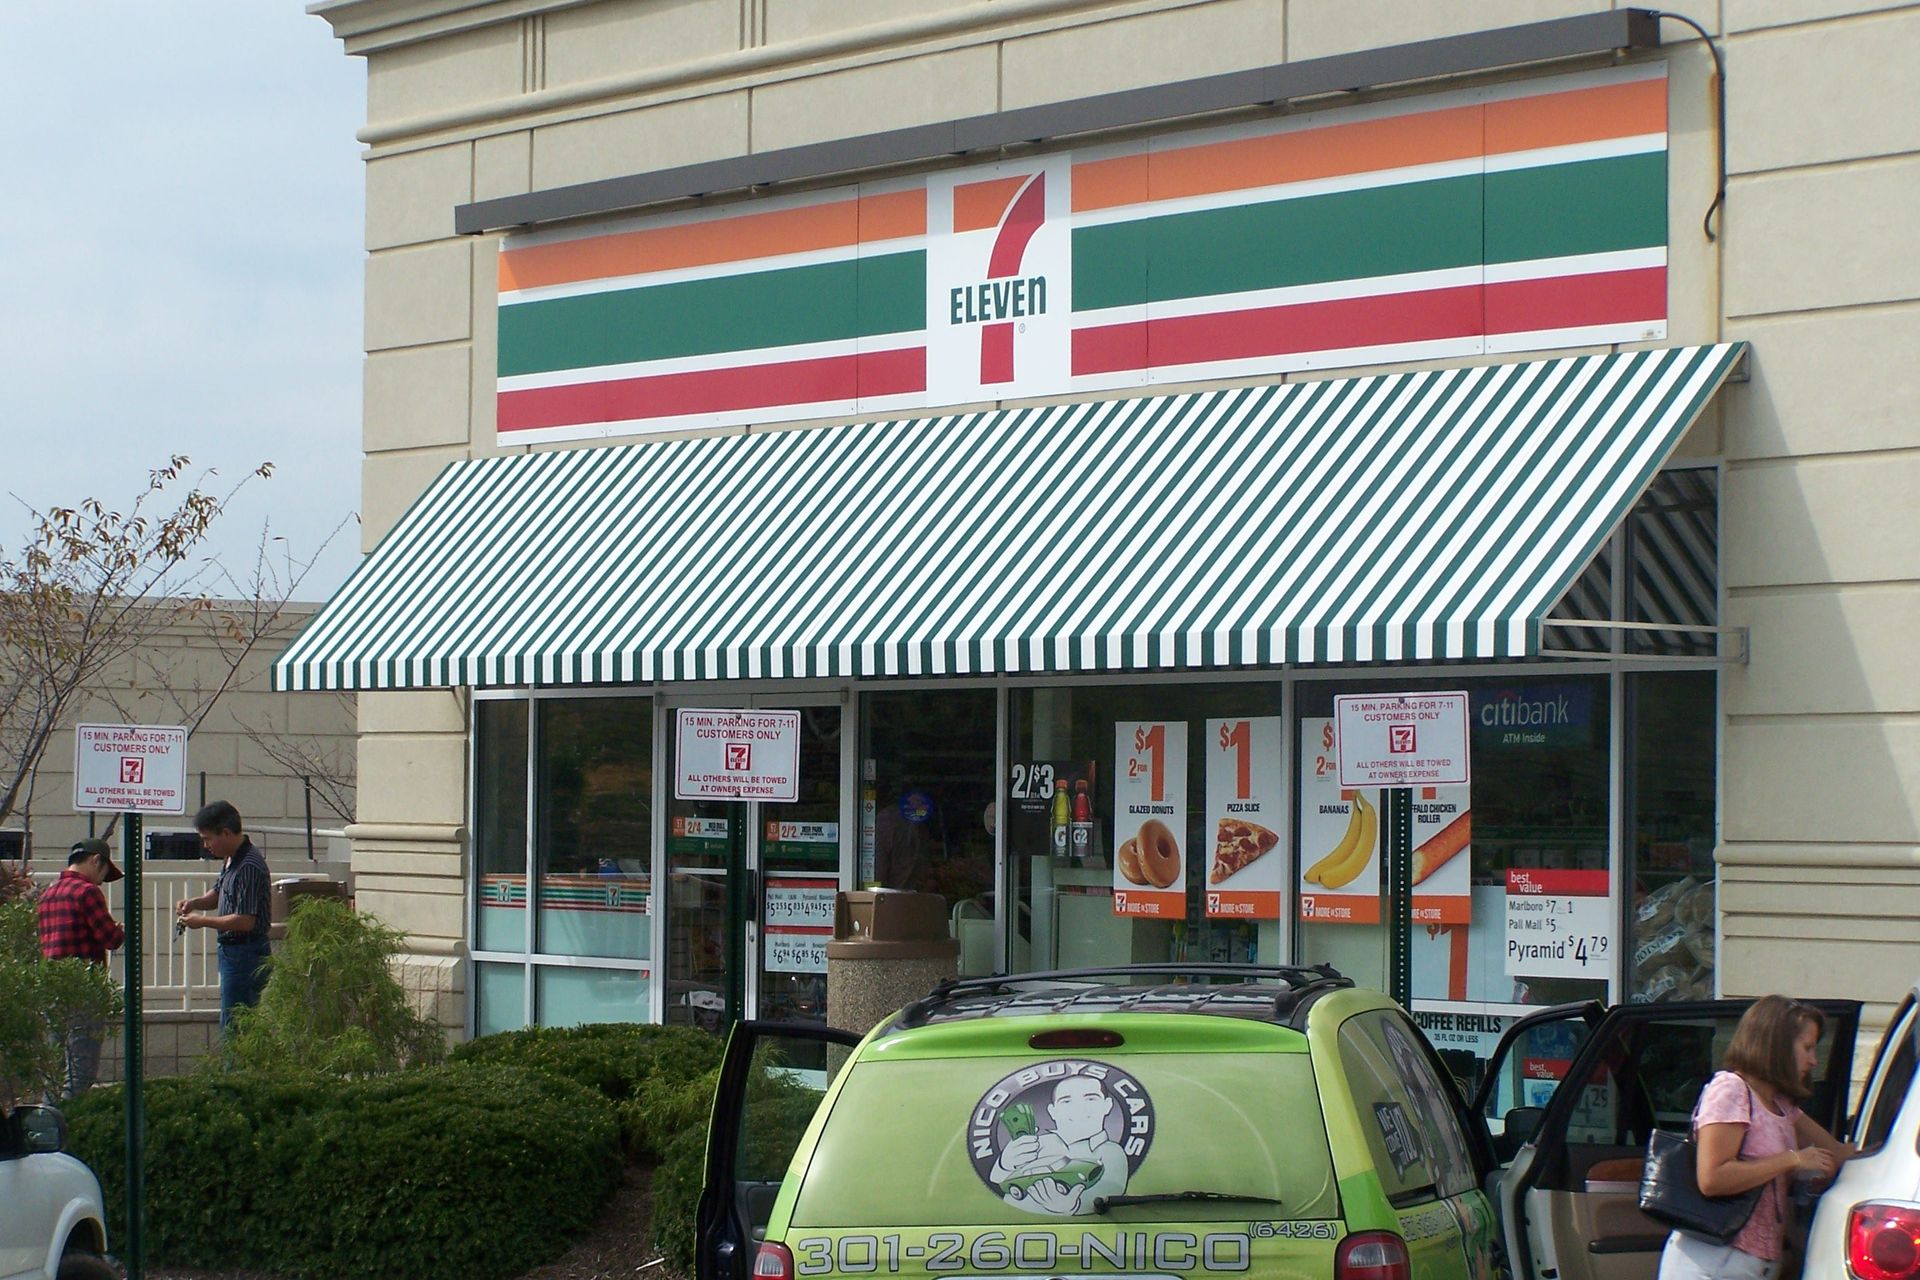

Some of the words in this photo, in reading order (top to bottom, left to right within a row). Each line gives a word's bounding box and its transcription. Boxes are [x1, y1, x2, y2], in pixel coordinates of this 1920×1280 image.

[953, 170, 1045, 384] 7
[1380, 702, 1418, 710] PARKING
[1419, 702, 1436, 710] FOR
[1438, 701, 1454, 709] 7-11
[1481, 694, 1568, 726] citibank
[685, 717, 694, 726] 15
[696, 718, 714, 726] MIN.
[717, 718, 756, 728] PARKING
[758, 720, 776, 728] FOR
[778, 720, 795, 728] 7-11
[1364, 712, 1416, 722] CUSTOMERS
[1418, 712, 1440, 720] ONLY
[83, 732, 92, 740] 15
[112, 732, 148, 742] PARKING
[150, 734, 166, 742] FOR
[168, 734, 182, 743] 7-11
[696, 729, 754, 740] CUSTOMERS
[756, 730, 781, 740] ONLY
[1502, 732, 1520, 744] ATM
[1522, 732, 1546, 743] Inside
[94, 743, 147, 754] CUSTOMERS
[148, 745, 170, 754] ONLY
[1135, 725, 1165, 801] $1
[1220, 721, 1250, 800] $1
[1316, 756, 1324, 775] 2
[1370, 760, 1398, 768] OTHERS
[1129, 758, 1137, 776] 2
[702, 775, 732, 783] OTHERS
[762, 776, 788, 784] TOWED
[1378, 771, 1408, 779] OWNERS
[1408, 770, 1440, 778] EXPENSE
[1129, 804, 1150, 814] GLAZED
[1152, 805, 1174, 814] DONUTS
[1226, 804, 1244, 812] PIZZA
[1244, 803, 1260, 812] SLICE
[1319, 804, 1350, 814] BANANAS
[1430, 804, 1456, 812] CHICKEN
[1418, 814, 1440, 824] ROLLER
[1054, 825, 1066, 847] G
[1073, 829, 1088, 844] G2
[1510, 871, 1530, 884] best
[1518, 881, 1543, 893] value
[1508, 900, 1544, 911] Marlboro
[1508, 919, 1523, 930] Pall
[1525, 920, 1542, 930] Mall
[1546, 918, 1556, 932] $5
[1508, 940, 1565, 962] Pyramid
[1413, 1012, 1453, 1030] COFFEE
[1456, 1014, 1502, 1033] REFILLS
[1465, 1035, 1478, 1043] LESS
[1530, 1062, 1545, 1071] best
[972, 1088, 1012, 1160] NICO
[1014, 1062, 1109, 1088] BUYS
[1112, 1078, 1149, 1157] CARS
[798, 1232, 1251, 1275] 301-260-NICO
[1248, 1222, 1338, 1240] (6426)
